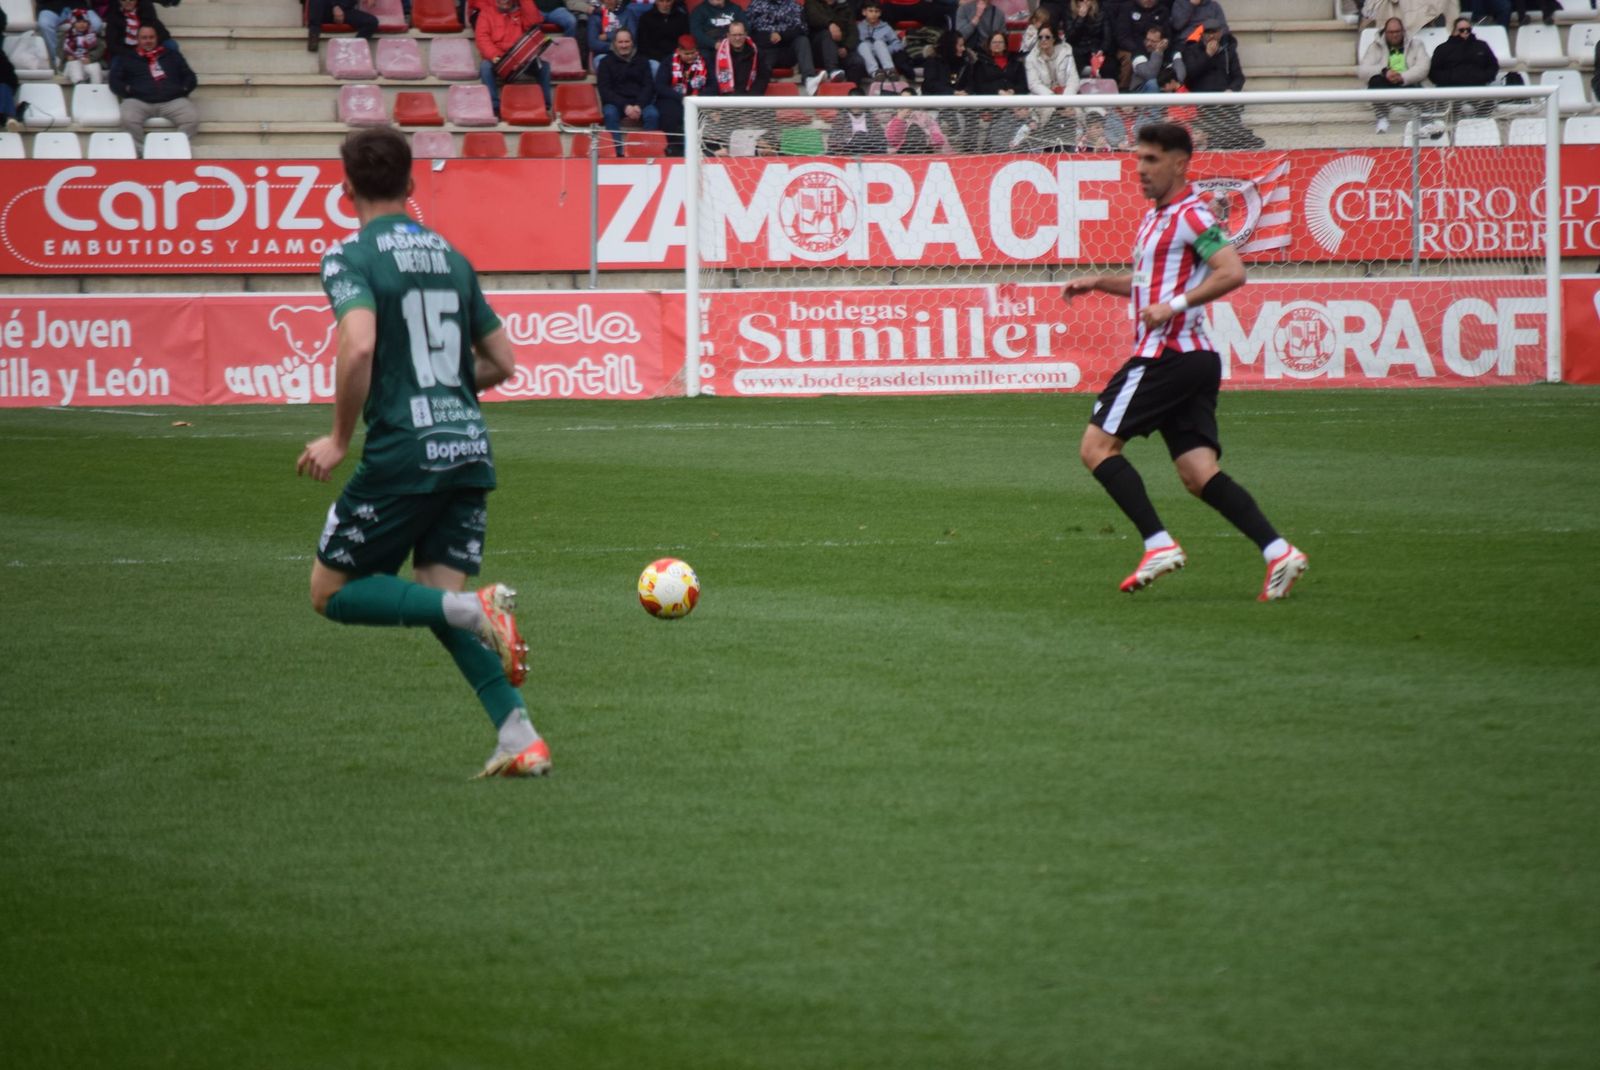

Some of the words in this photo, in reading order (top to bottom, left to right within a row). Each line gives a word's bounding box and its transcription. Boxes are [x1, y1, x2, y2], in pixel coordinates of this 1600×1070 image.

[597, 161, 983, 263] ZAMORA
[988, 159, 1122, 260] CF
[1335, 187, 1518, 223] CENTRO
[43, 239, 214, 256] EMBUTIDOS
[226, 240, 238, 254] Y
[248, 238, 338, 255] JAMO
[0, 308, 24, 348] é
[31, 310, 131, 348] Joven
[738, 306, 1068, 364] Sumiller
[790, 300, 908, 326] bodegas
[401, 288, 463, 389] 15
[1204, 299, 1437, 379] MORA
[1442, 297, 1547, 378] CF
[57, 368, 79, 406] y
[87, 356, 170, 397] León
[739, 368, 1068, 391] www.bodegasdelsumiller.com
